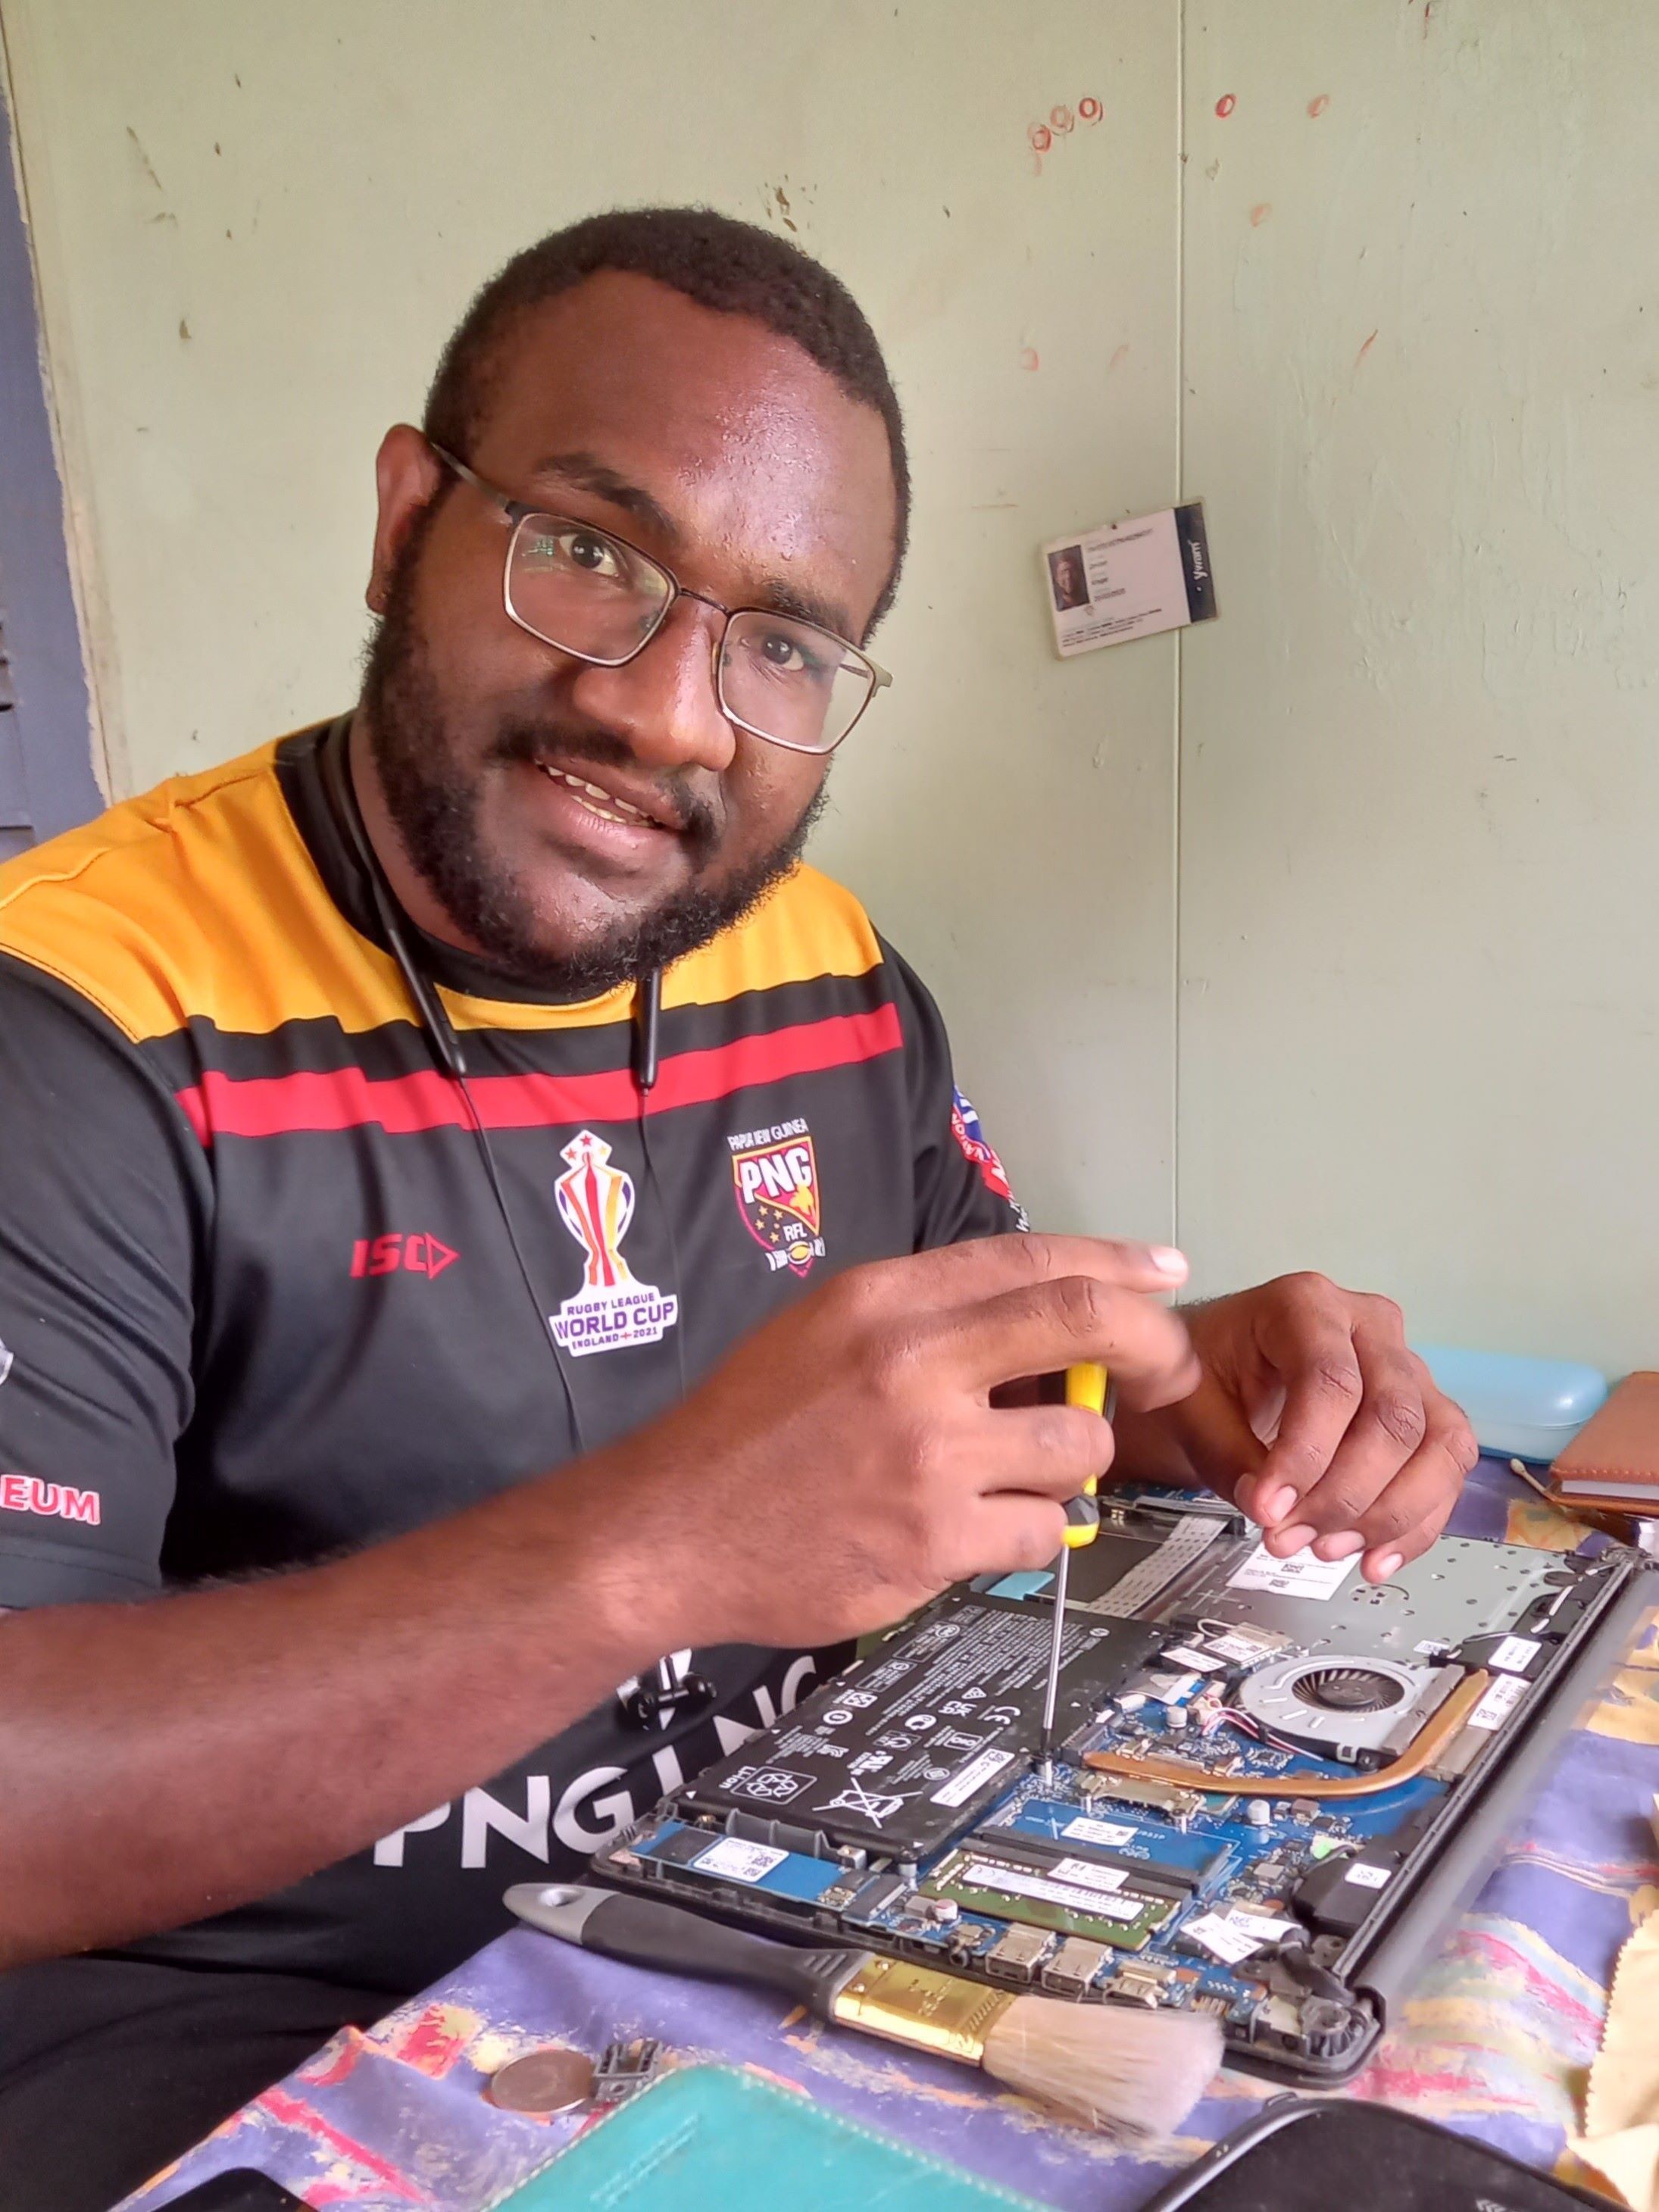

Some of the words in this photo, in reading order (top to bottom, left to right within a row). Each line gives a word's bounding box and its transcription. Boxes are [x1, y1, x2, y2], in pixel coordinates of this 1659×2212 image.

[739, 1146, 812, 1204] PNG
[783, 1222, 808, 1242] RFL
[567, 1301, 607, 1316] RUGBY
[611, 1292, 655, 1309] LEAGUE
[555, 1311, 627, 1339] WORLD
[633, 1301, 674, 1326] CUP
[571, 1333, 620, 1350] ENGLAND
[633, 1326, 658, 1339] 2021
